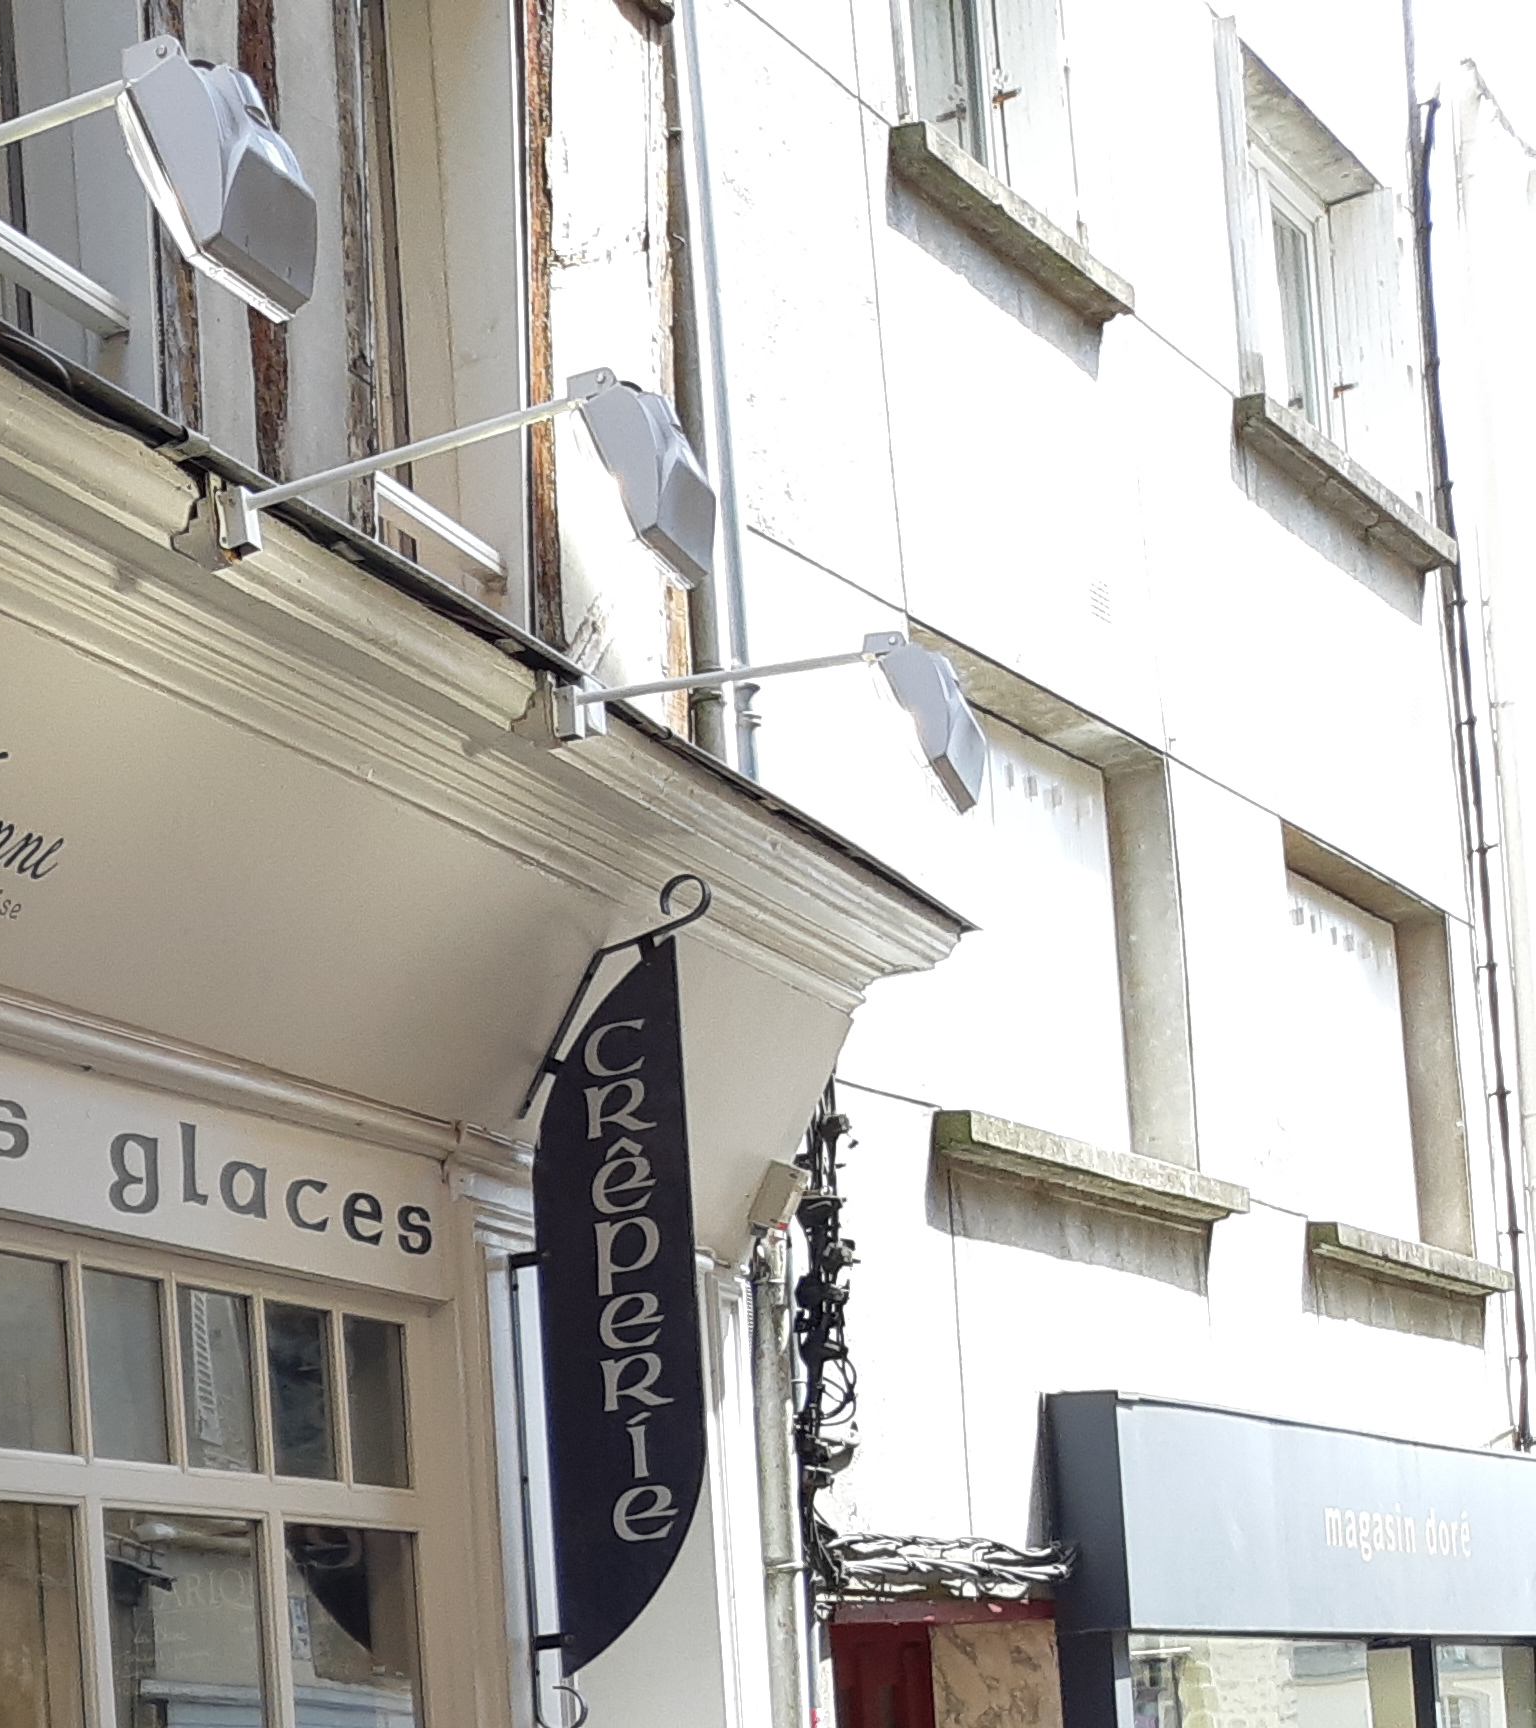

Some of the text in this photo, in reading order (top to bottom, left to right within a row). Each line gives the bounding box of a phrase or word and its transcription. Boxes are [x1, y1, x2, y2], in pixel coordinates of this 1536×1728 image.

[106, 1120, 434, 1256] glaces
[1324, 1502, 1472, 1562] magasin doré
